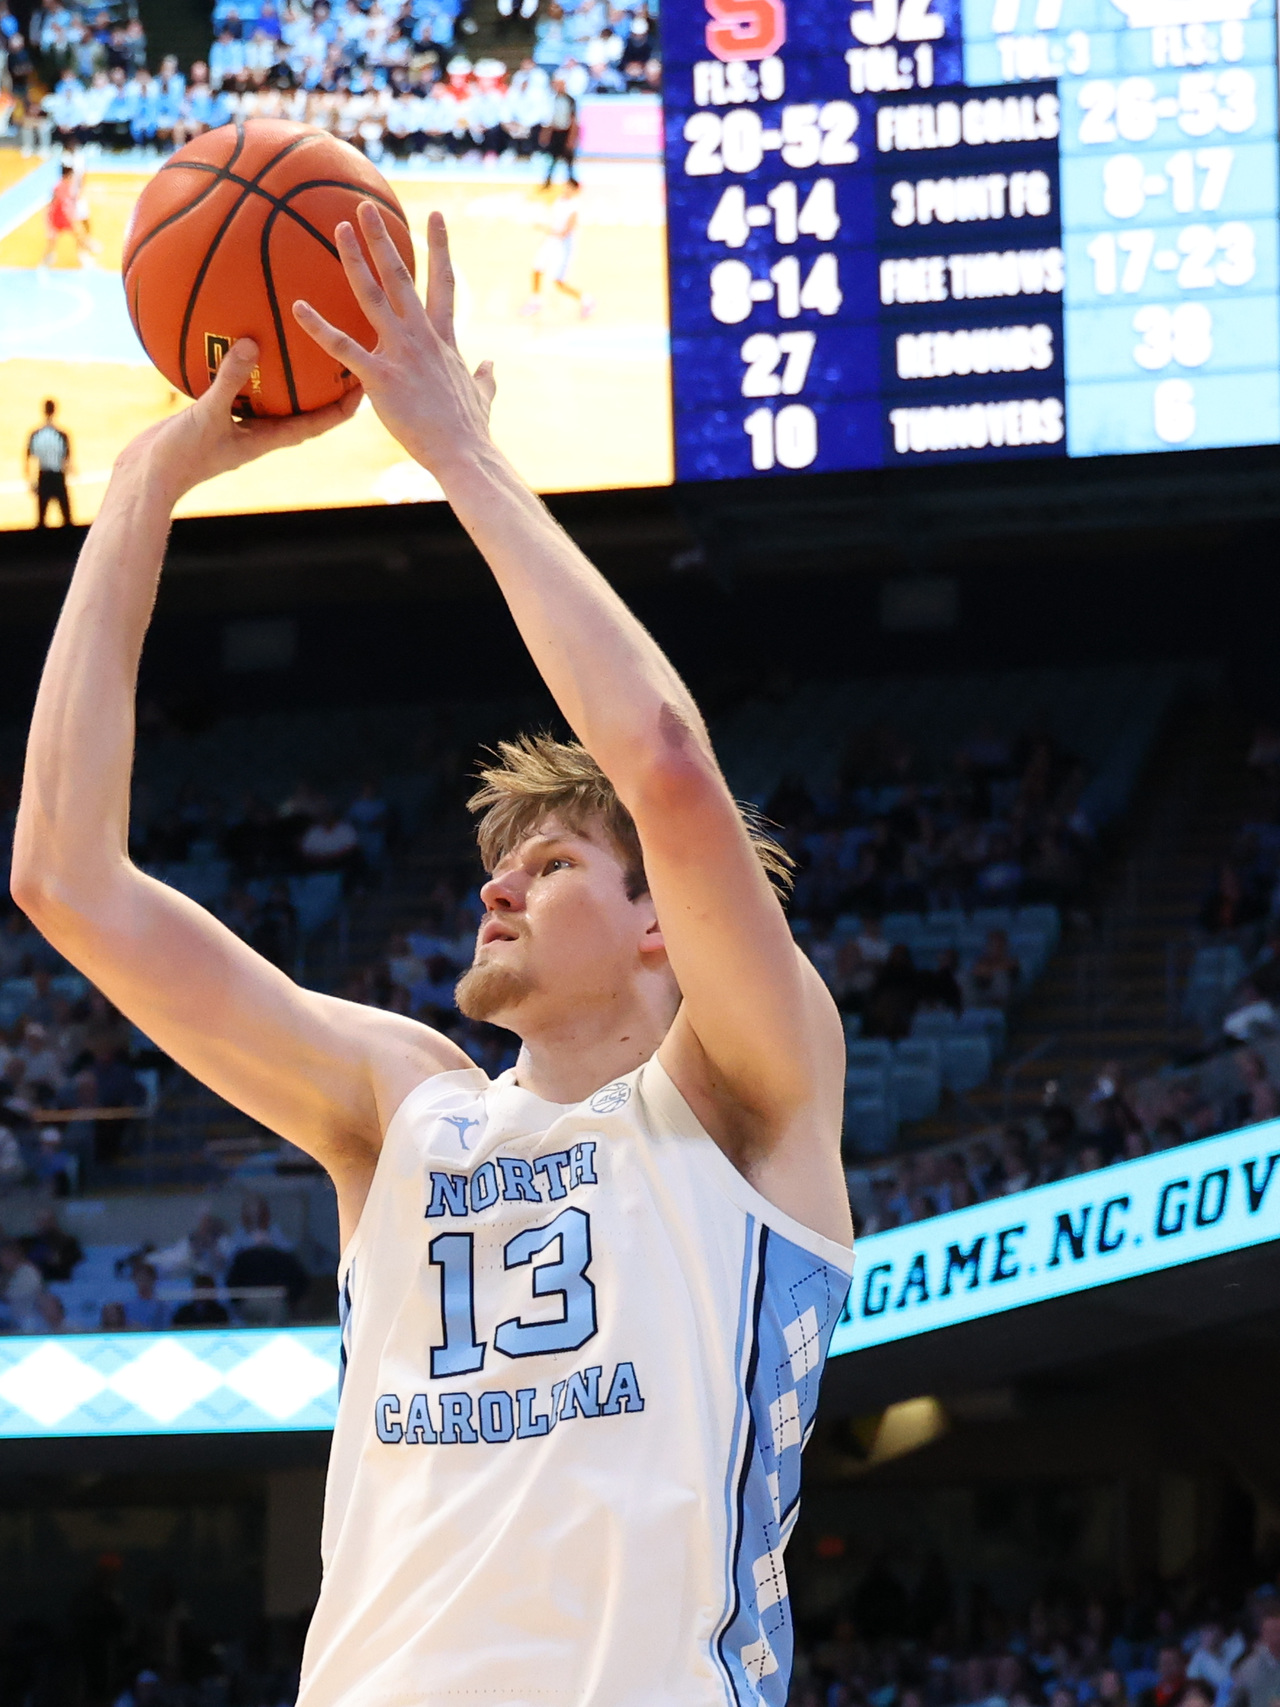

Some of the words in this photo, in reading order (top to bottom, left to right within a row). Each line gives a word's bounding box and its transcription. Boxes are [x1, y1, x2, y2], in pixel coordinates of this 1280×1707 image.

[915, 43, 934, 88] 1
[684, 100, 860, 176] 20-52
[1078, 67, 1257, 144] 26-53
[707, 178, 840, 248] 4-14
[1102, 147, 1235, 219] 8-17
[710, 252, 842, 324] 8-14
[1087, 222, 1255, 296] 17-23
[741, 331, 816, 398] 27
[743, 403, 818, 470] 10
[424, 1142, 597, 1218] NORTH
[429, 1206, 598, 1379] 13
[375, 1362, 645, 1444] CAROLINA
